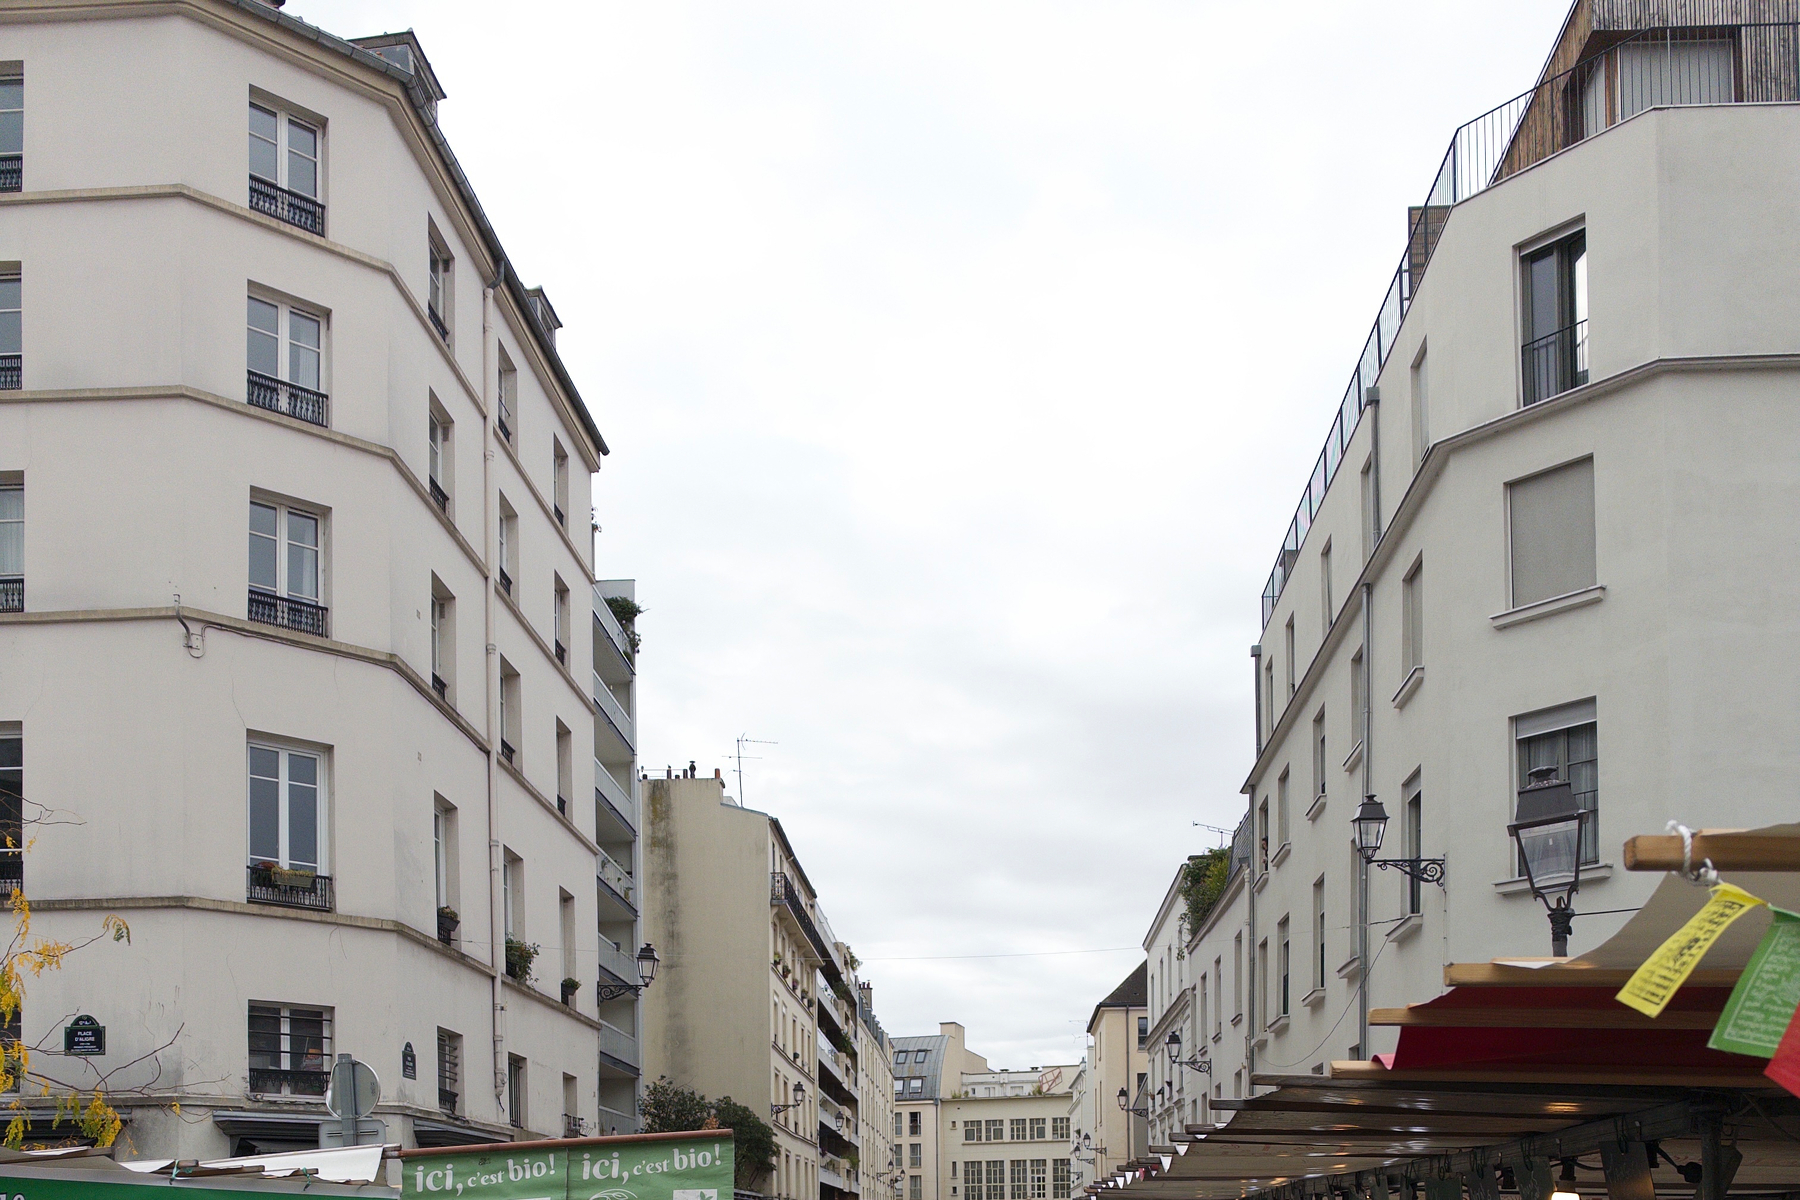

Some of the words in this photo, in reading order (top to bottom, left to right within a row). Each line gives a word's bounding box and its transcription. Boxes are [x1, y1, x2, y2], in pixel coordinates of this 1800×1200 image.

[414, 1163, 463, 1197] ici,
[467, 1170, 505, 1187] c'est
[506, 1153, 556, 1182] bio!
[581, 1151, 629, 1185] ici,
[633, 1159, 670, 1176] c'est
[672, 1143, 721, 1170] bio!
